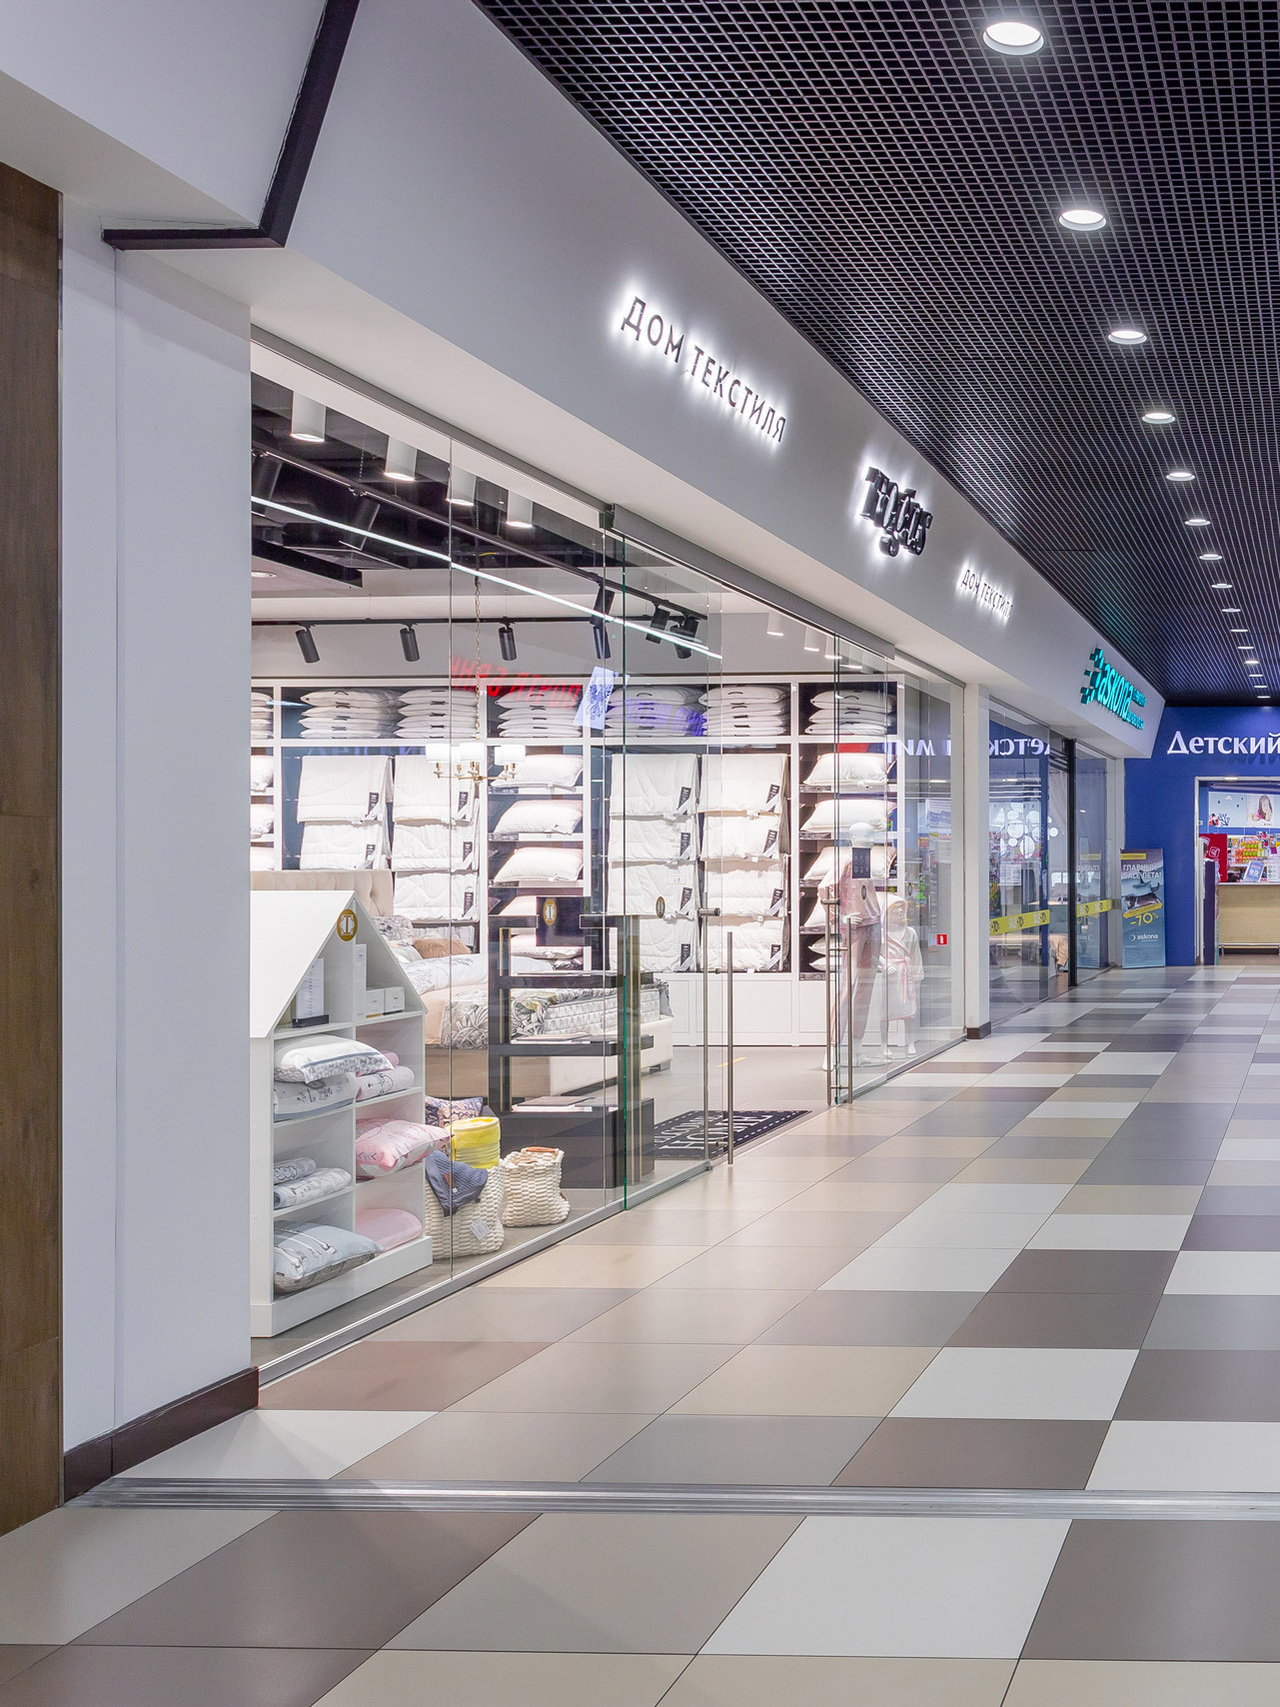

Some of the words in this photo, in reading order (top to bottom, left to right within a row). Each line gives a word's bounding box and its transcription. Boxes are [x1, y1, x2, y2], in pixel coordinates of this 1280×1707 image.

[620, 296, 685, 363] ДОМ
[690, 344, 787, 443] ТЕКСТИЛЯ
[960, 568, 981, 595] ДОМ
[979, 581, 1014, 619] ТЕКСТИЛЯ
[1096, 663, 1134, 720] askona
